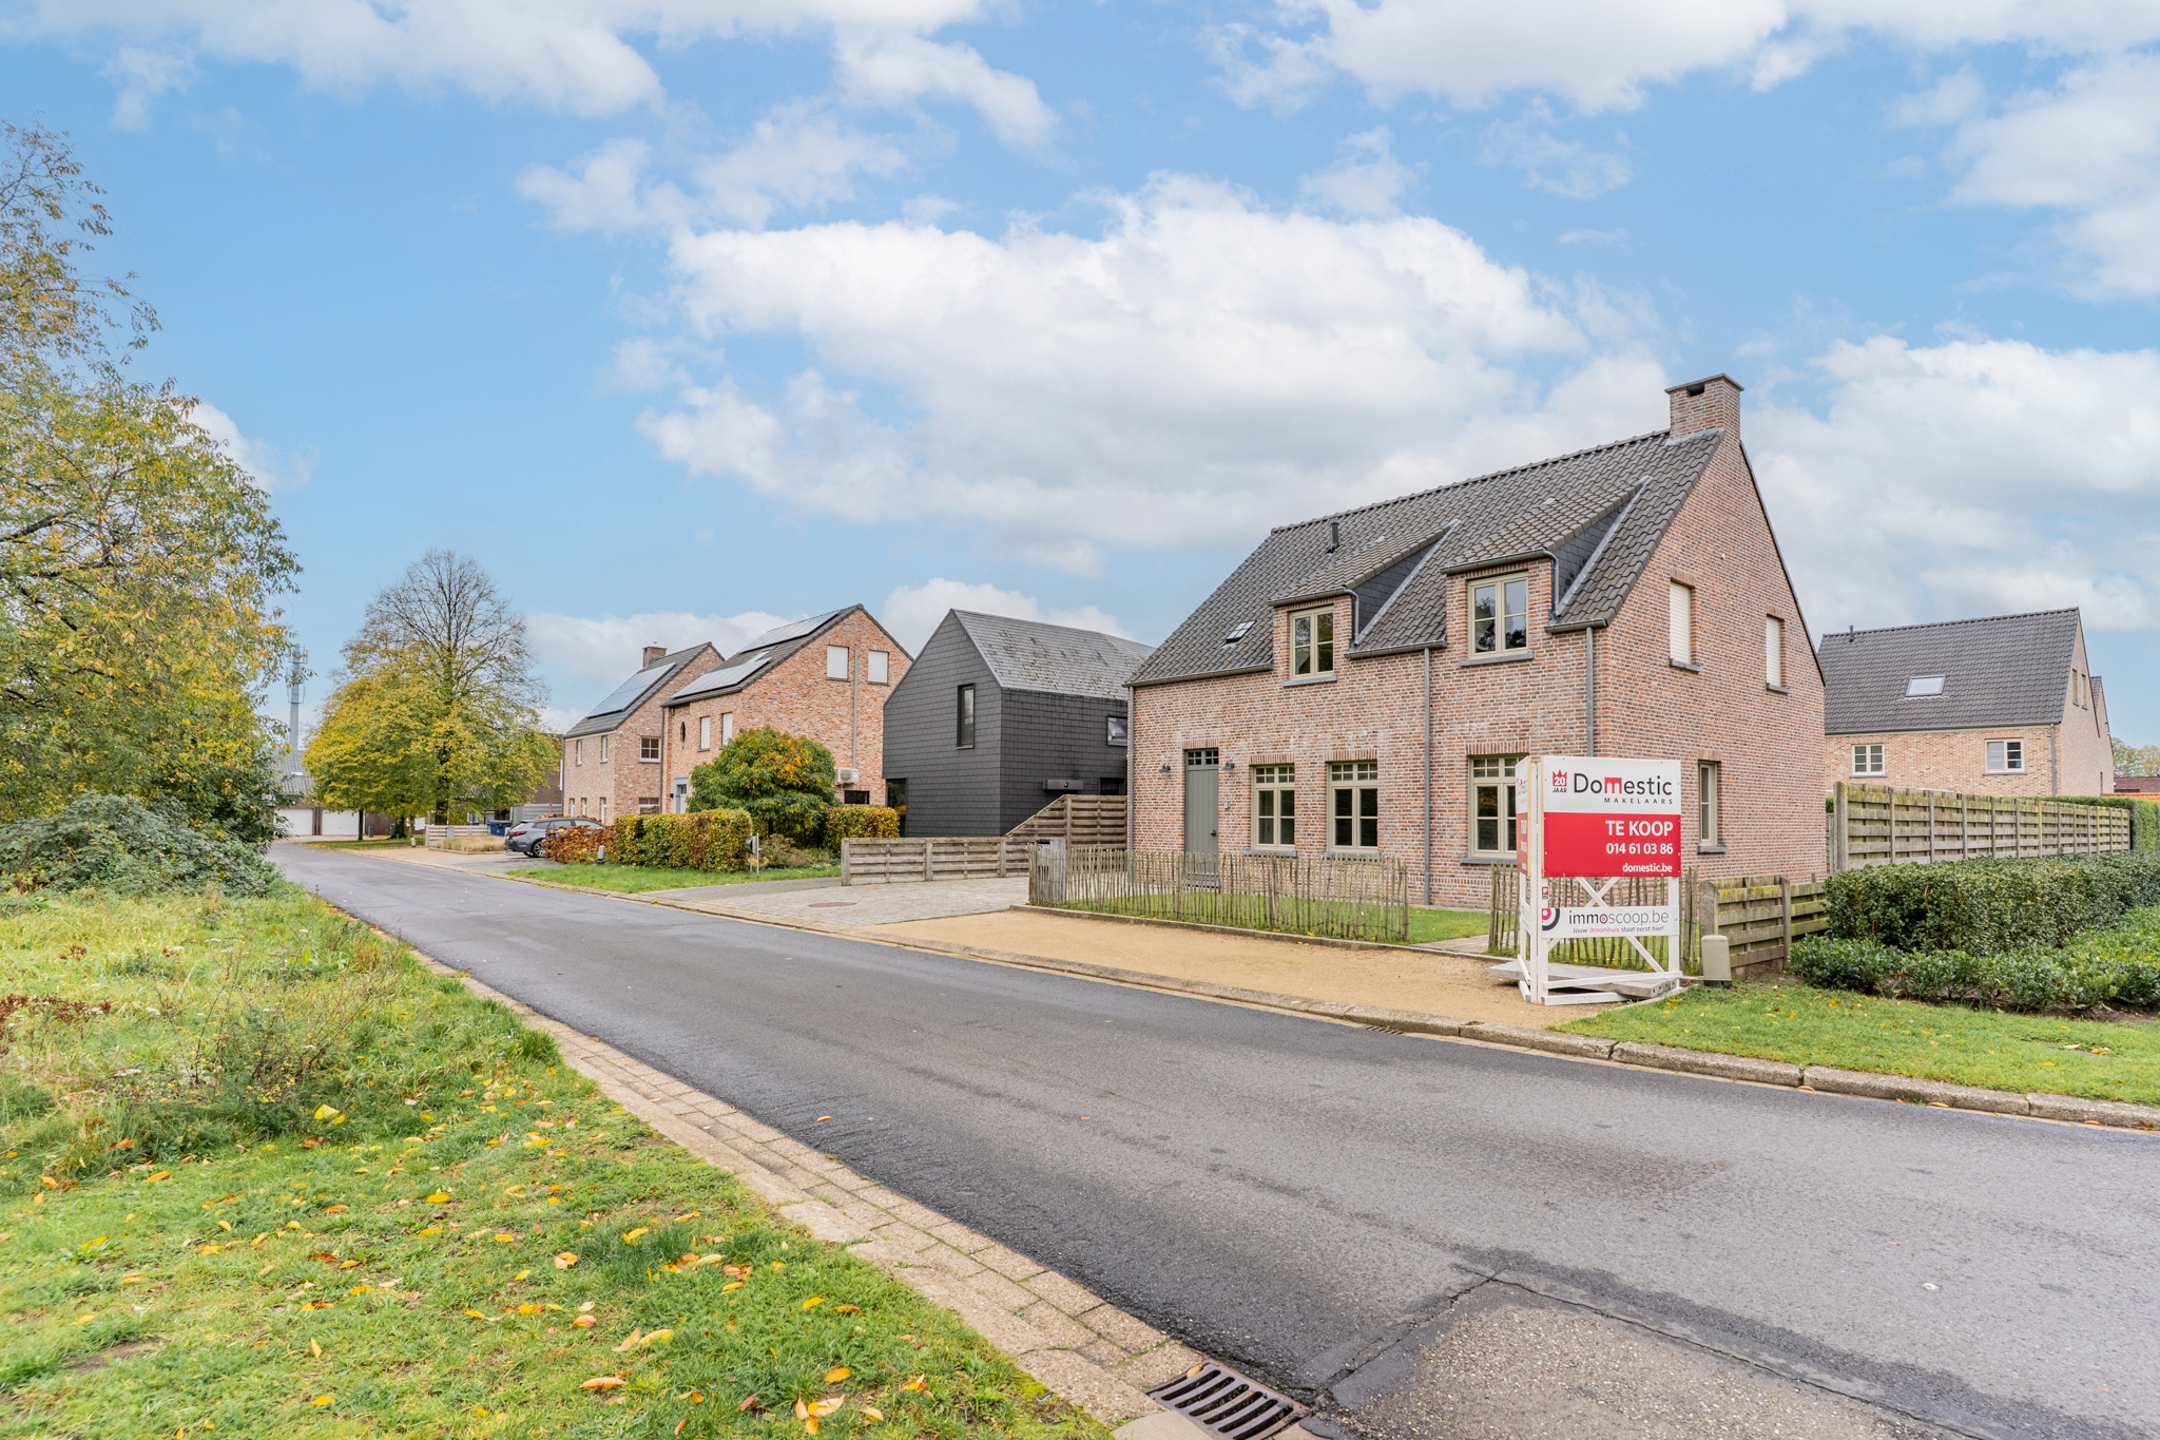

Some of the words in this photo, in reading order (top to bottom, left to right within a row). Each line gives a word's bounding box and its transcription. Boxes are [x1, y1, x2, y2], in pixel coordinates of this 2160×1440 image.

[1554, 776, 1566, 786] 20
[1573, 773, 1673, 796] Domestic
[1603, 797, 1673, 805] MAKELAARS
[1605, 820, 1625, 836] TE
[1628, 820, 1674, 837] KOOP
[1605, 842, 1626, 855] 014
[1628, 842, 1641, 855] 61
[1643, 843, 1658, 855] 03
[1659, 843, 1674, 855] 86
[1622, 862, 1673, 873] domestic.be
[1568, 909, 1670, 926] immoscoop.be
[1589, 925, 1620, 934] droomhuis
